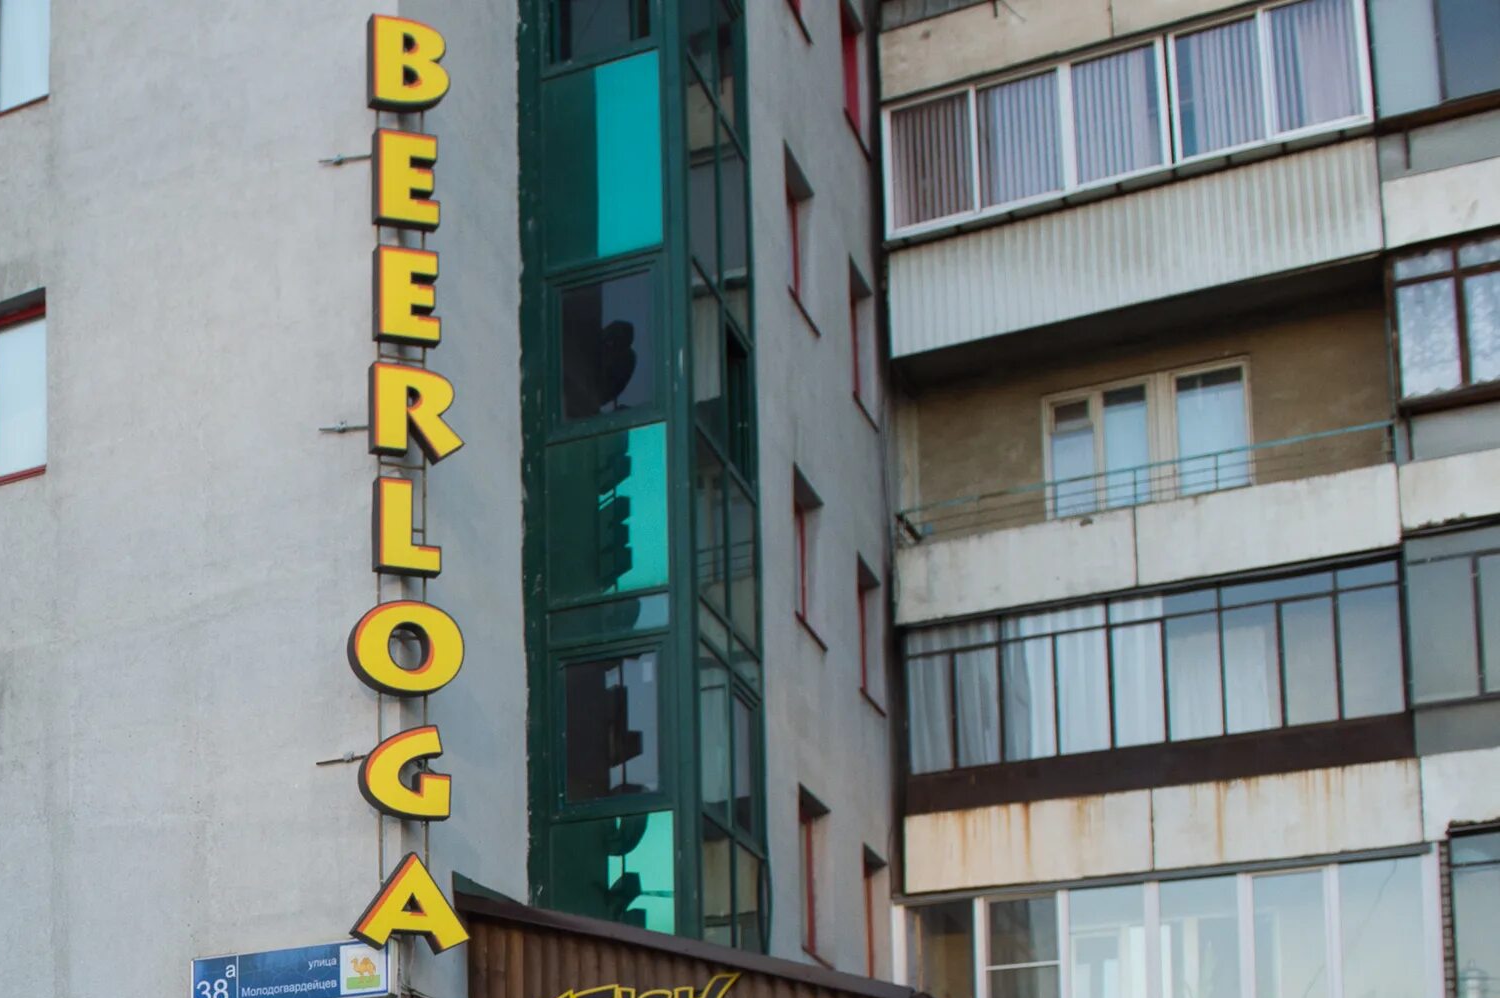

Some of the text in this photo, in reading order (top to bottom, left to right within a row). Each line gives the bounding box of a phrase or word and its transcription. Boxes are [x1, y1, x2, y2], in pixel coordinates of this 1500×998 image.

[347, 12, 471, 956] BEERLOGA
[307, 956, 338, 970] улица
[241, 978, 338, 998] Молодогвардейцев
